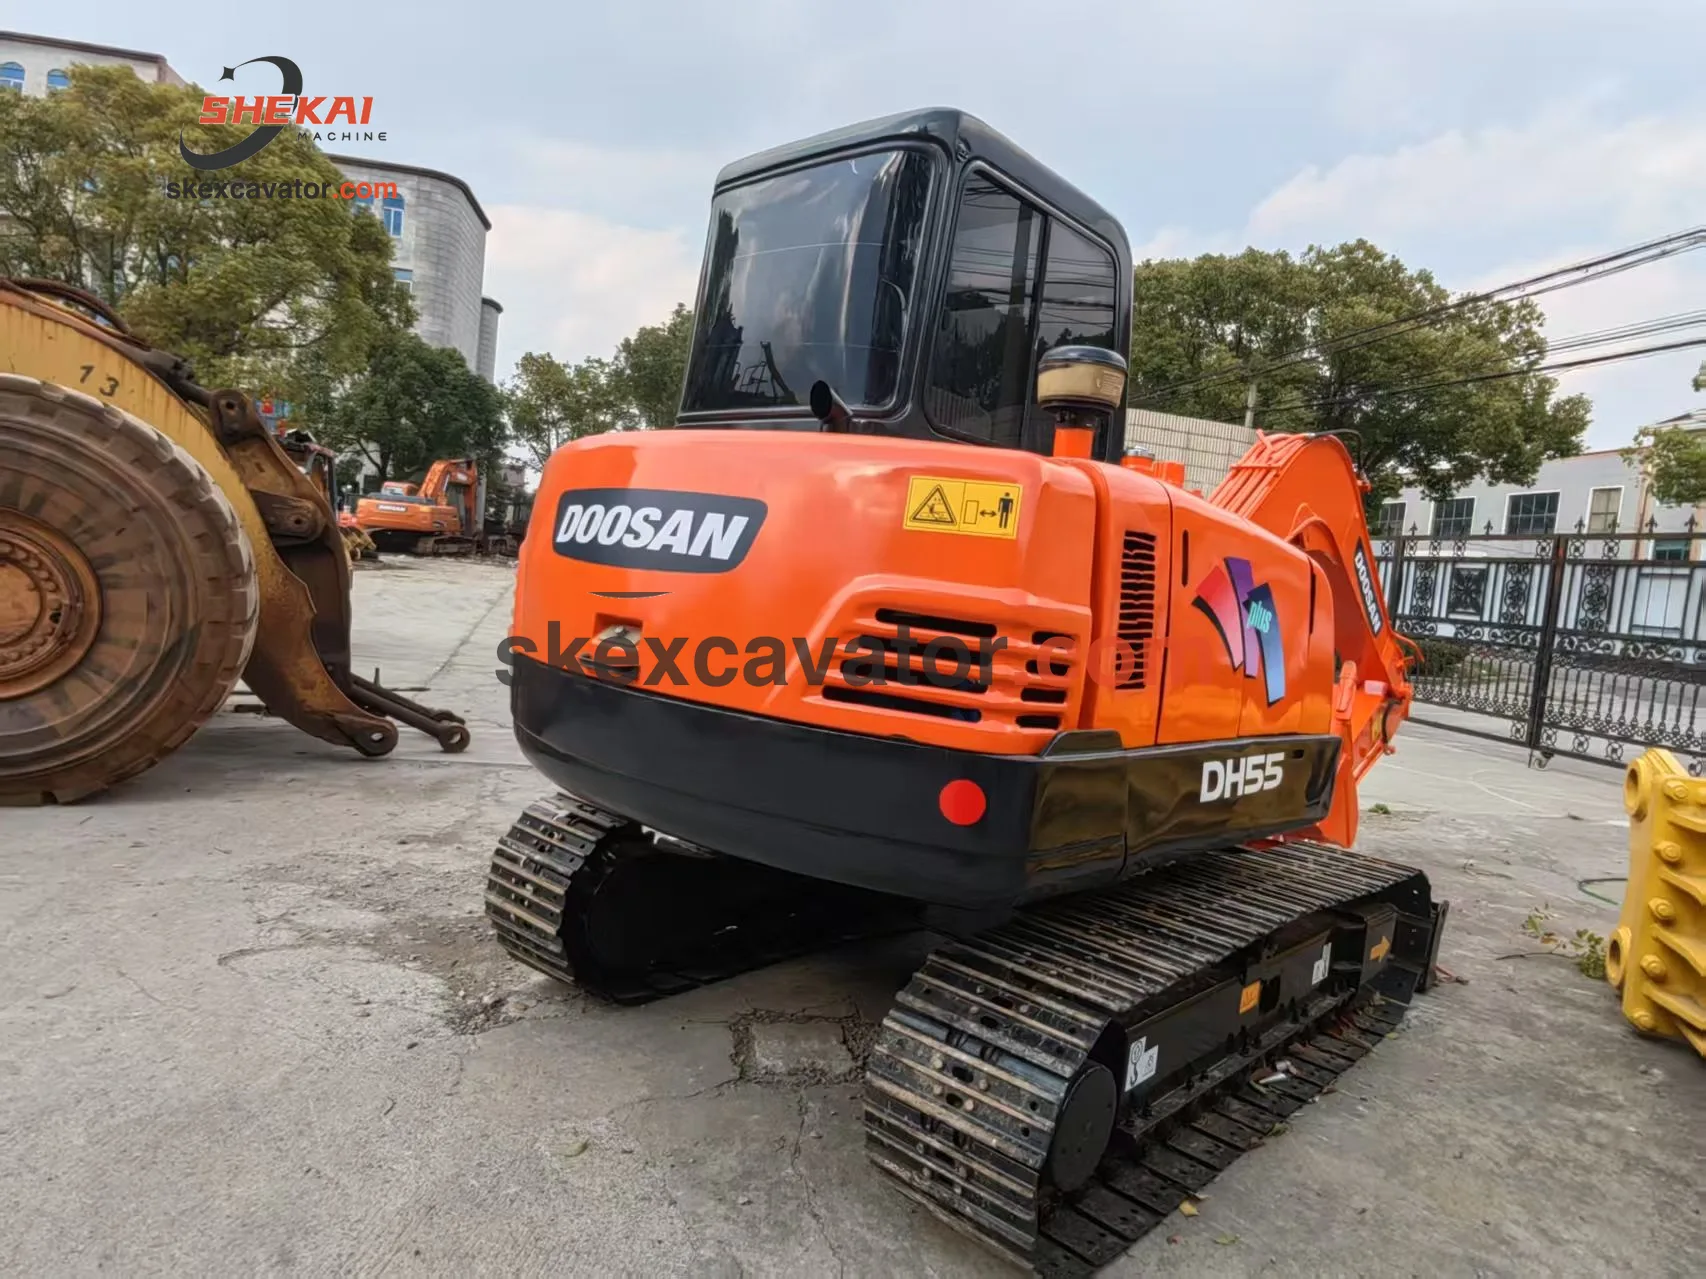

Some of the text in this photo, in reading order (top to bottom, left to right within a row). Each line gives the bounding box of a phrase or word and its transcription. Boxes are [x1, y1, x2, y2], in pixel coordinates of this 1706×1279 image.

[555, 503, 749, 561] DOOSAN
[1246, 600, 1273, 633] plus
[1354, 551, 1382, 634] DOOSAN
[1200, 751, 1285, 803] DH55
